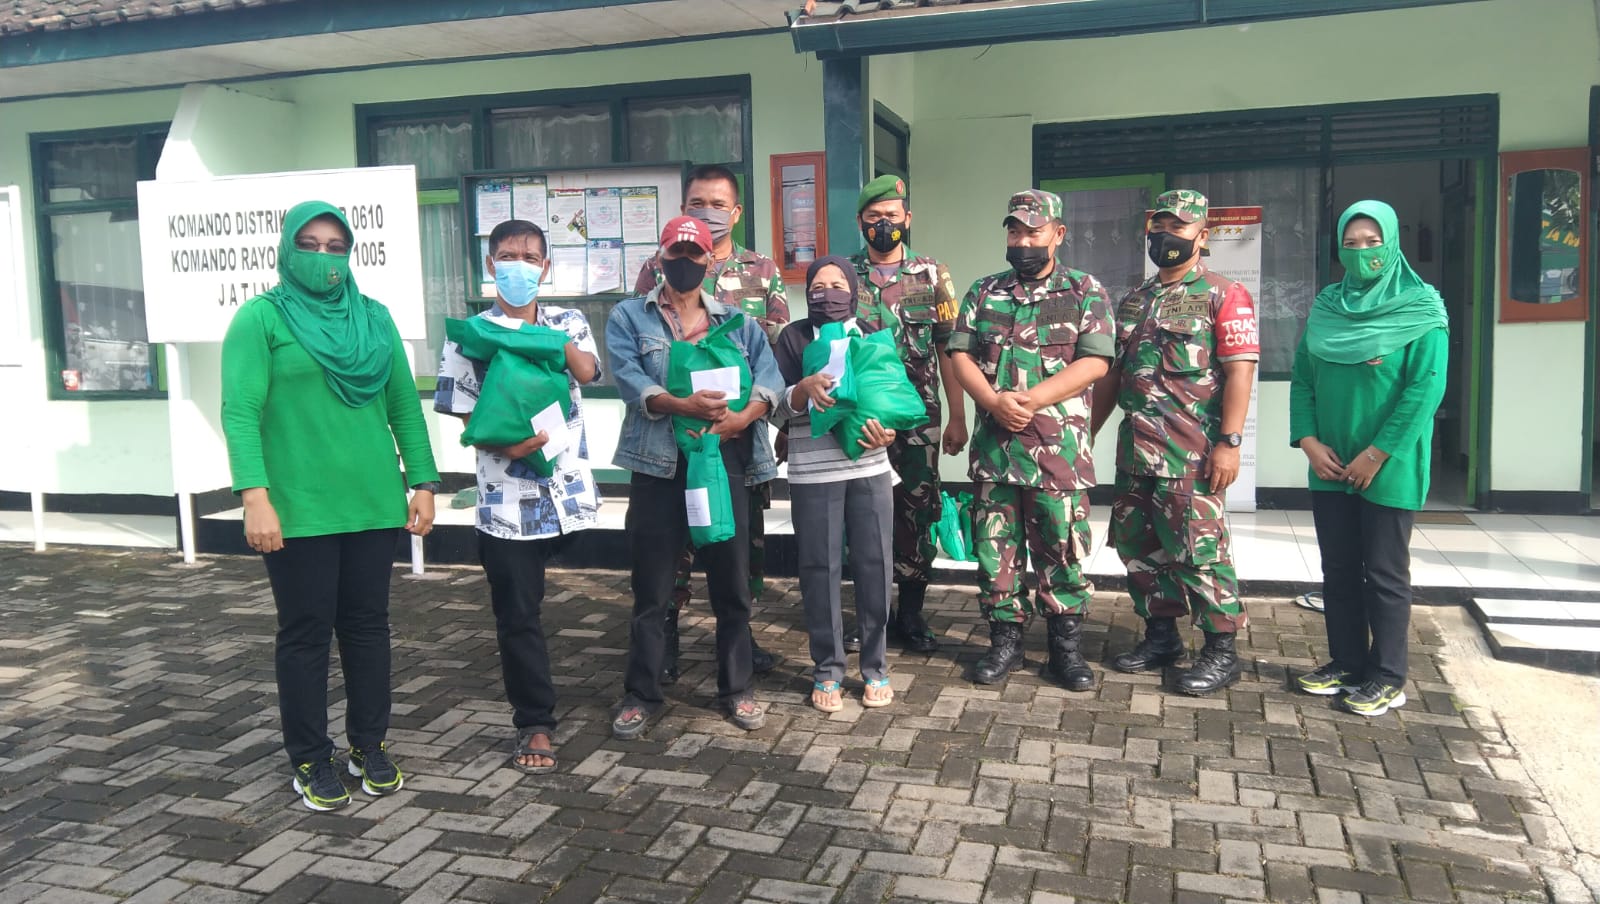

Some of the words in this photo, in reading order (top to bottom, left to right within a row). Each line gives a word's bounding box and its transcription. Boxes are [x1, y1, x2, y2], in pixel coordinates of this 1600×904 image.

[168, 212, 232, 238] KOMANDO
[352, 204, 383, 230] 0610
[171, 247, 237, 273] KOMANDO
[241, 246, 280, 271] RAYO
[353, 241, 386, 267] 1005
